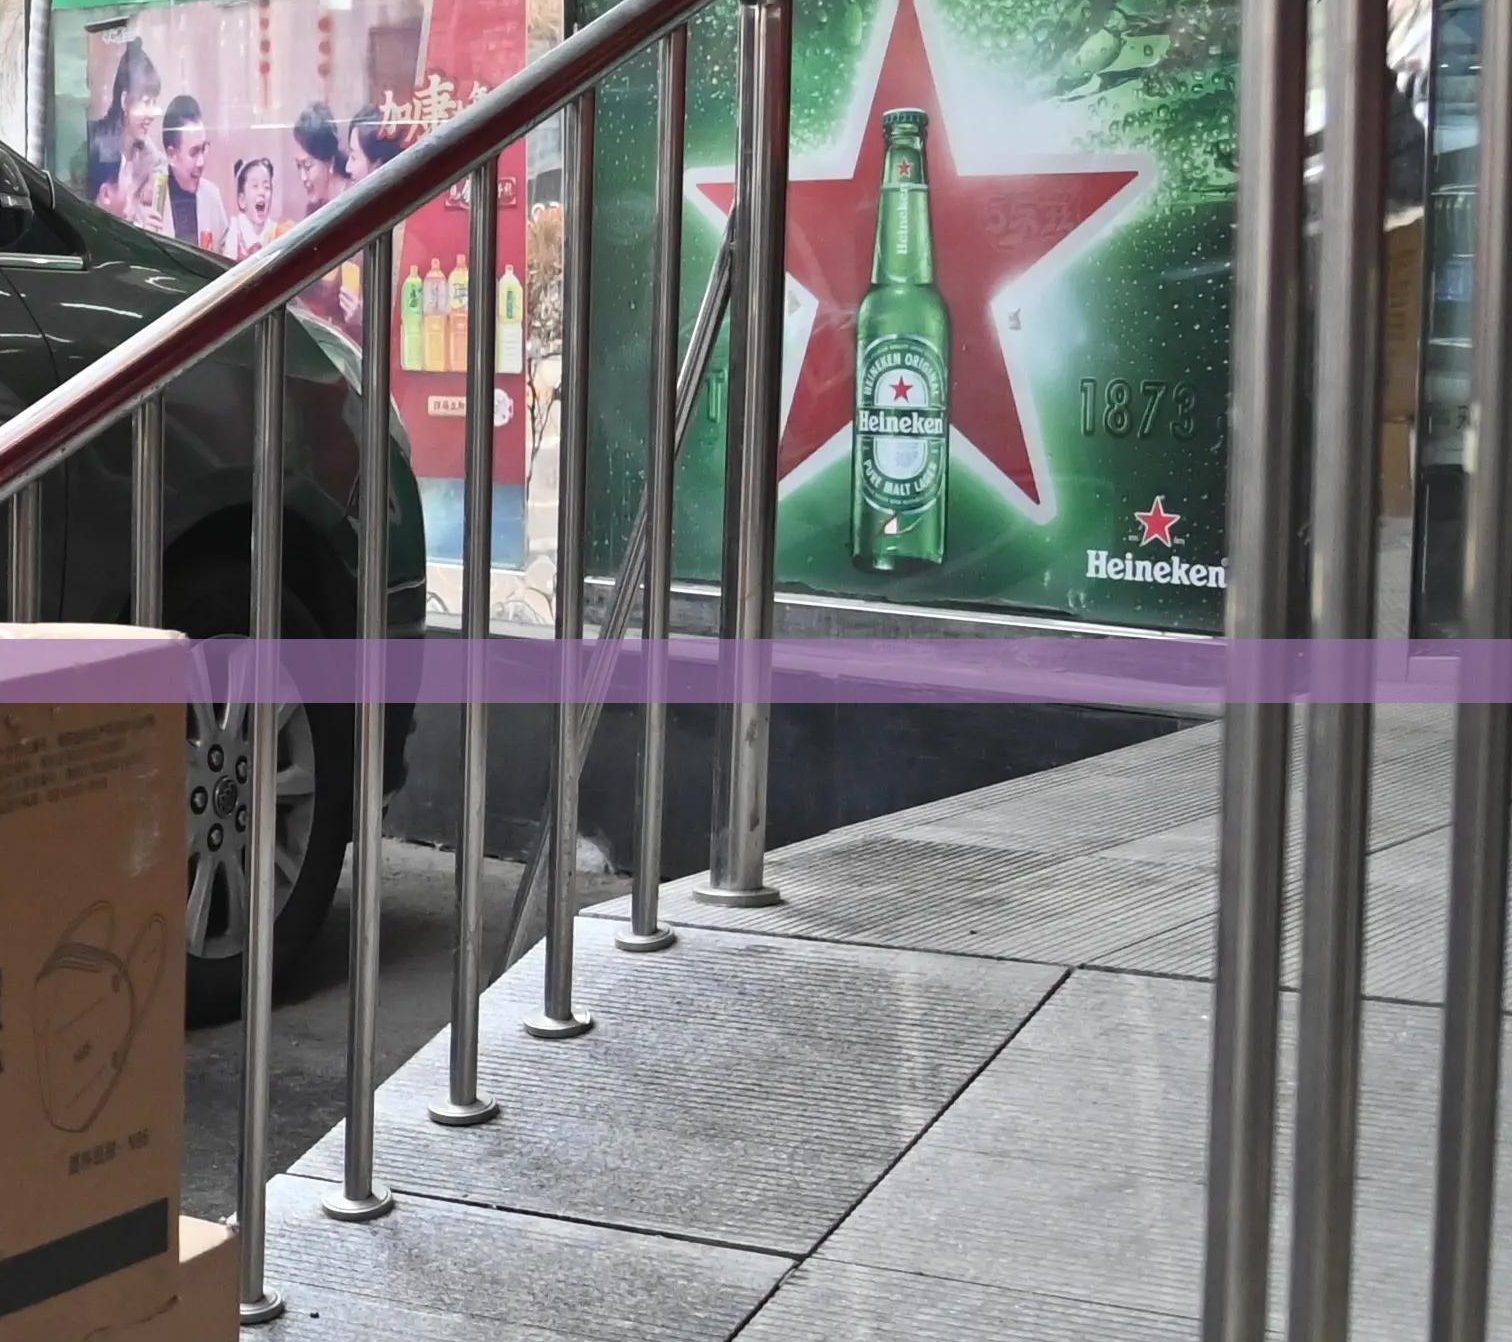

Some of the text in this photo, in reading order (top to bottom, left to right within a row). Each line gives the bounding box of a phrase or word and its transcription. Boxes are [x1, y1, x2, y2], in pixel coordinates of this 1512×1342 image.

[858, 410, 944, 435] Heineken
[1079, 376, 1198, 442] 1873
[1085, 548, 1228, 589] Heineken
